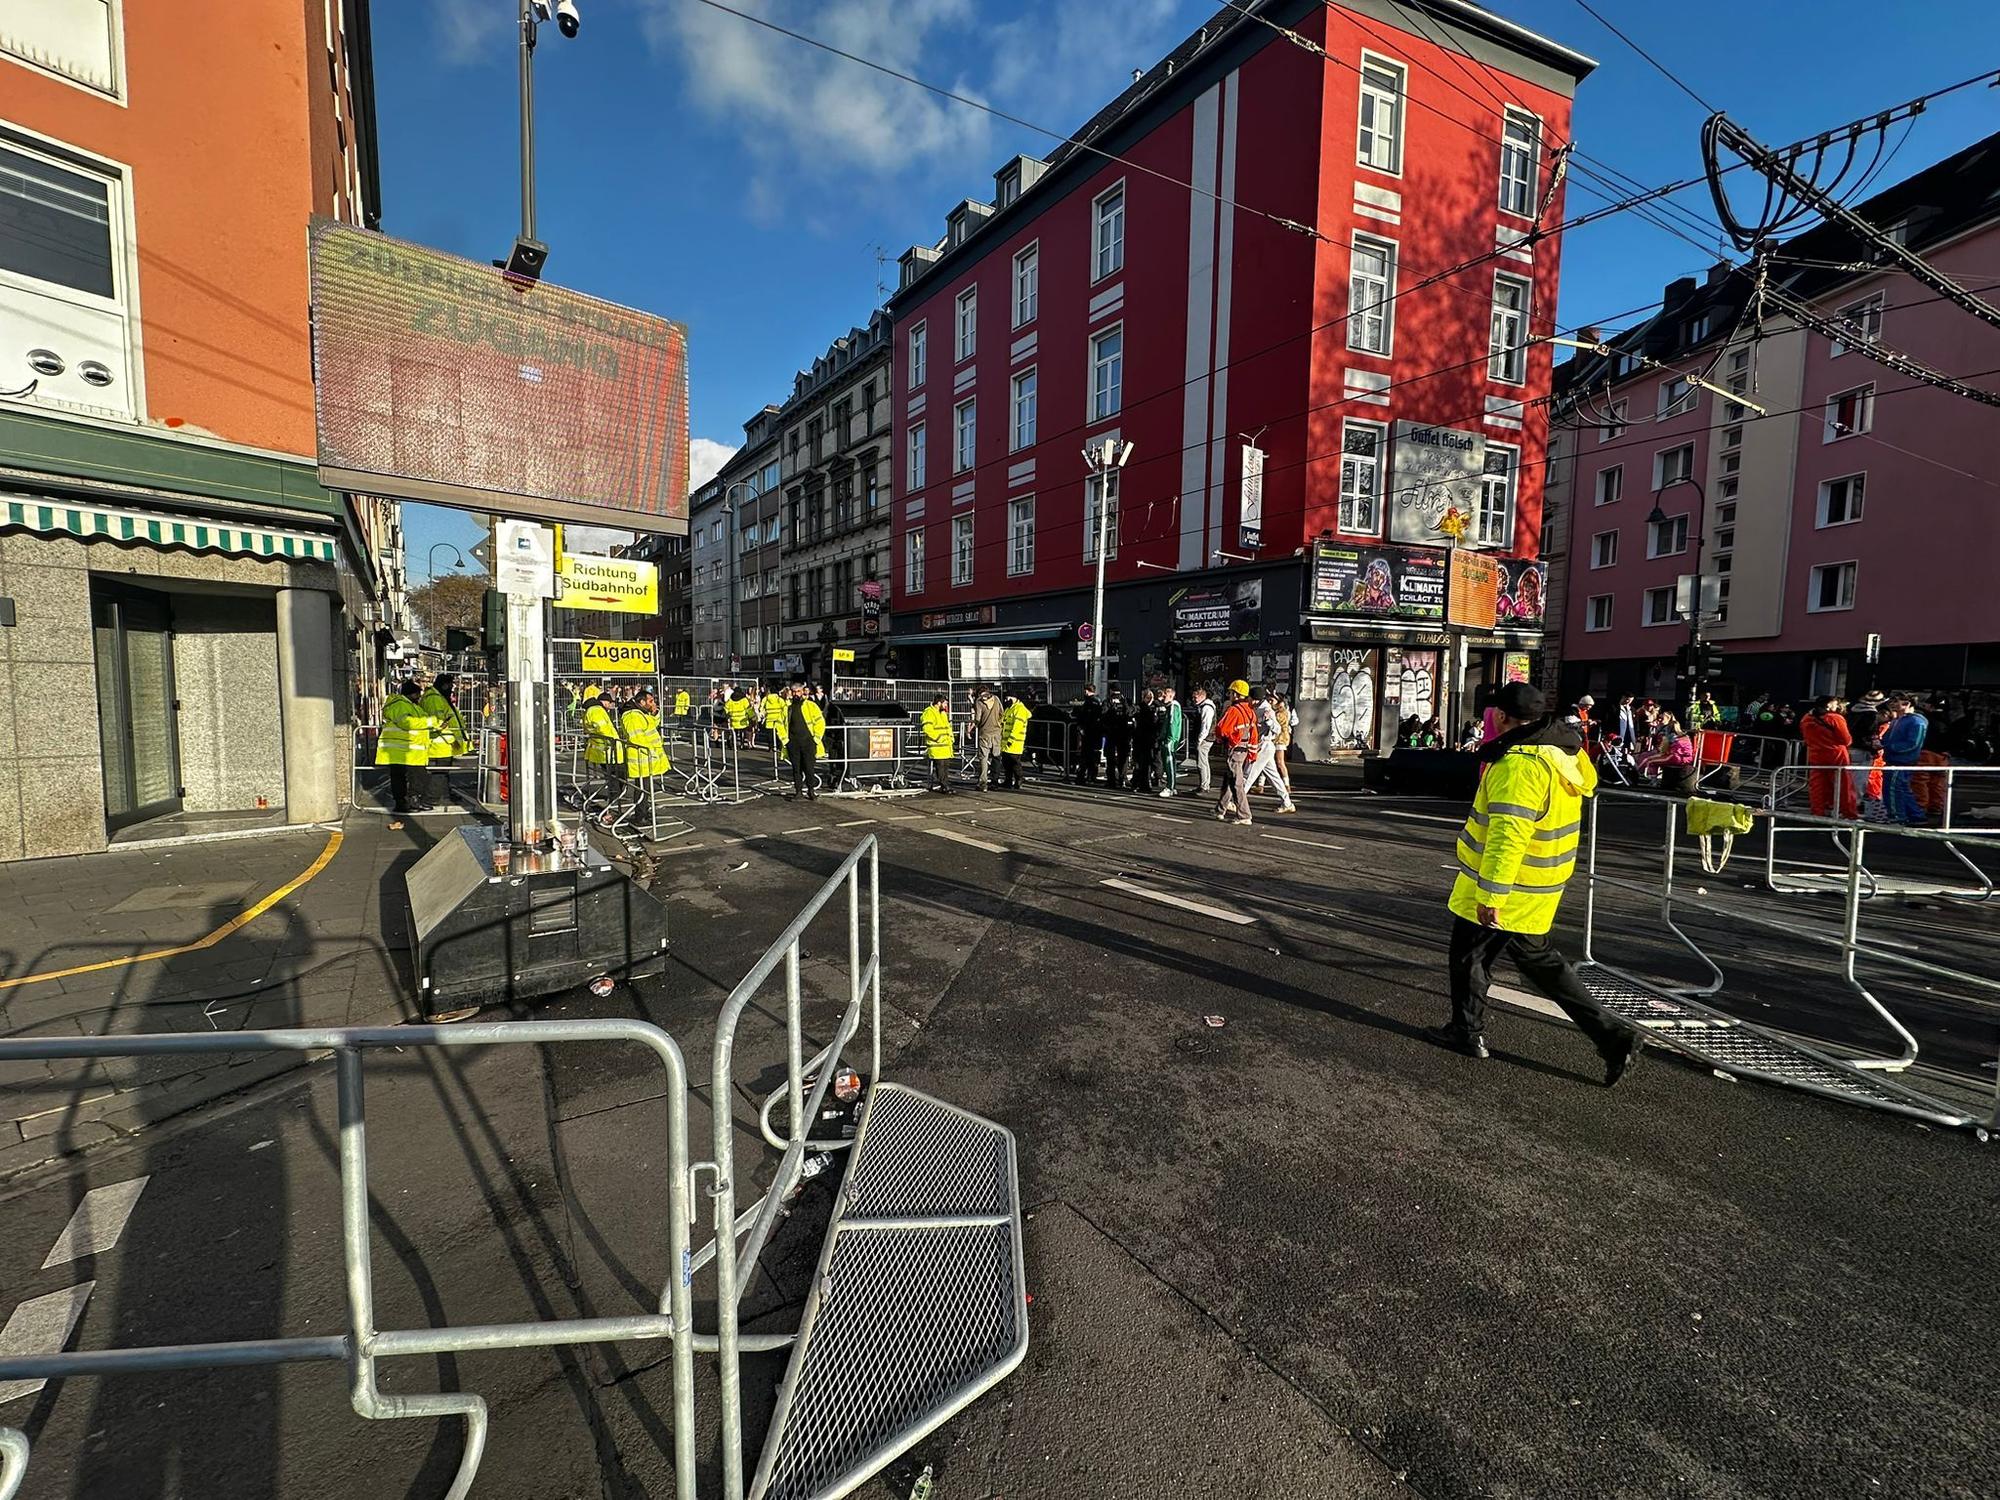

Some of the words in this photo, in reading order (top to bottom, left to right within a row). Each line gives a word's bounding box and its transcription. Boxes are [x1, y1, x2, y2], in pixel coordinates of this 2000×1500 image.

[412, 299, 619, 380] ZUGANG
[1411, 427, 1440, 447] Gaffel
[1441, 432, 1474, 452] Kölsch
[573, 562, 637, 583] Richtung
[562, 577, 649, 596] Südbahnhof
[863, 601, 880, 610] GYROS
[1416, 633, 1451, 644] FILMDOS
[584, 641, 652, 664] Zugang
